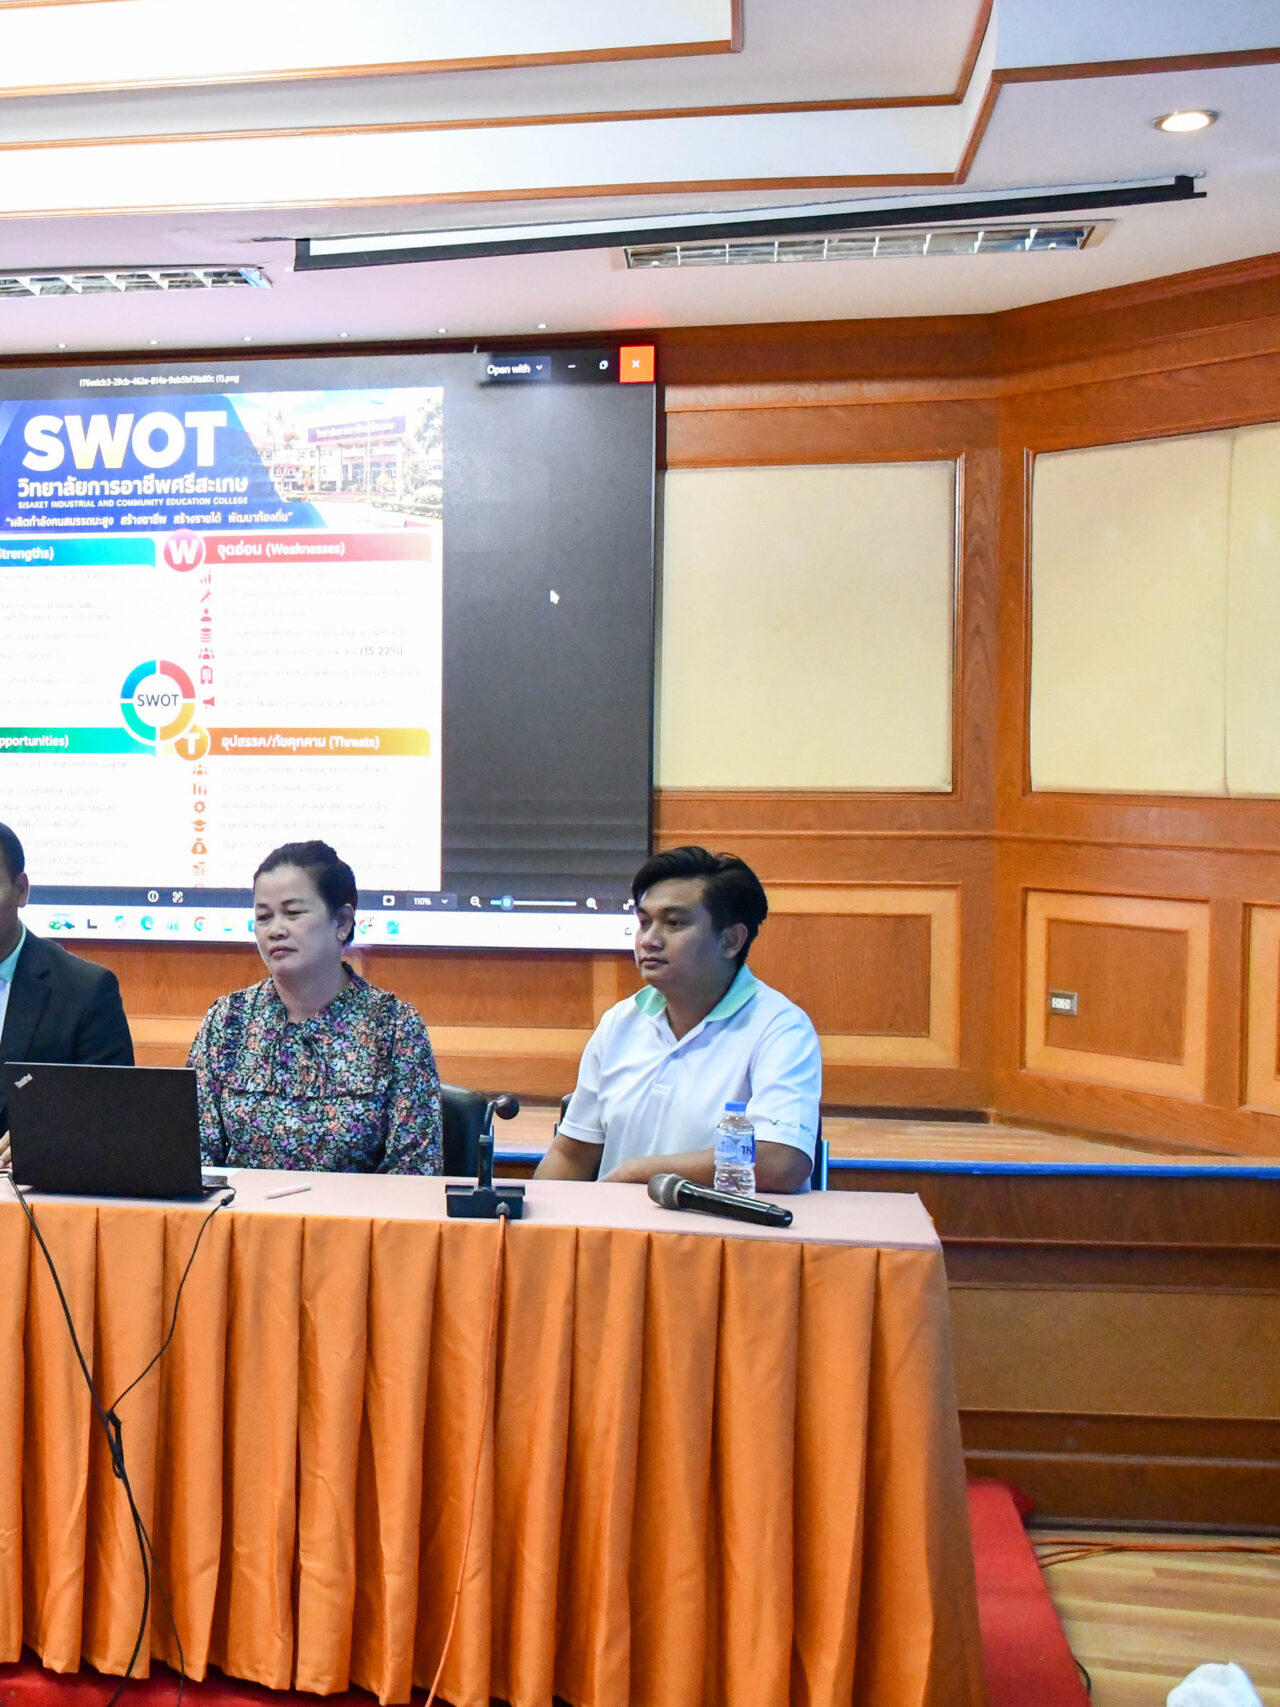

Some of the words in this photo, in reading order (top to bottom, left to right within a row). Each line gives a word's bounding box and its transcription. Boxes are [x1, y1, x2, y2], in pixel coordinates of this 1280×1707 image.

[487, 364, 510, 376] Open
[511, 364, 531, 374] with
[22, 410, 227, 472] SWOT
[17, 472, 249, 498] วิทยาลัยการอาชีพศรีสะเกษ
[17, 500, 49, 509] SISAKET
[51, 499, 96, 508] INDUSTRIAL
[97, 499, 115, 507] AND
[116, 497, 164, 507] COMMUNITY
[166, 496, 212, 506] EDUCATION
[213, 496, 249, 505] COLLEGE
[168, 539, 199, 565] W
[217, 539, 263, 561] จุดอ่อน
[265, 541, 346, 557] (Weaknesses)
[137, 693, 179, 707] SWOT
[183, 732, 201, 755] T
[328, 734, 380, 750] (Threats)
[413, 896, 432, 906] 110%
